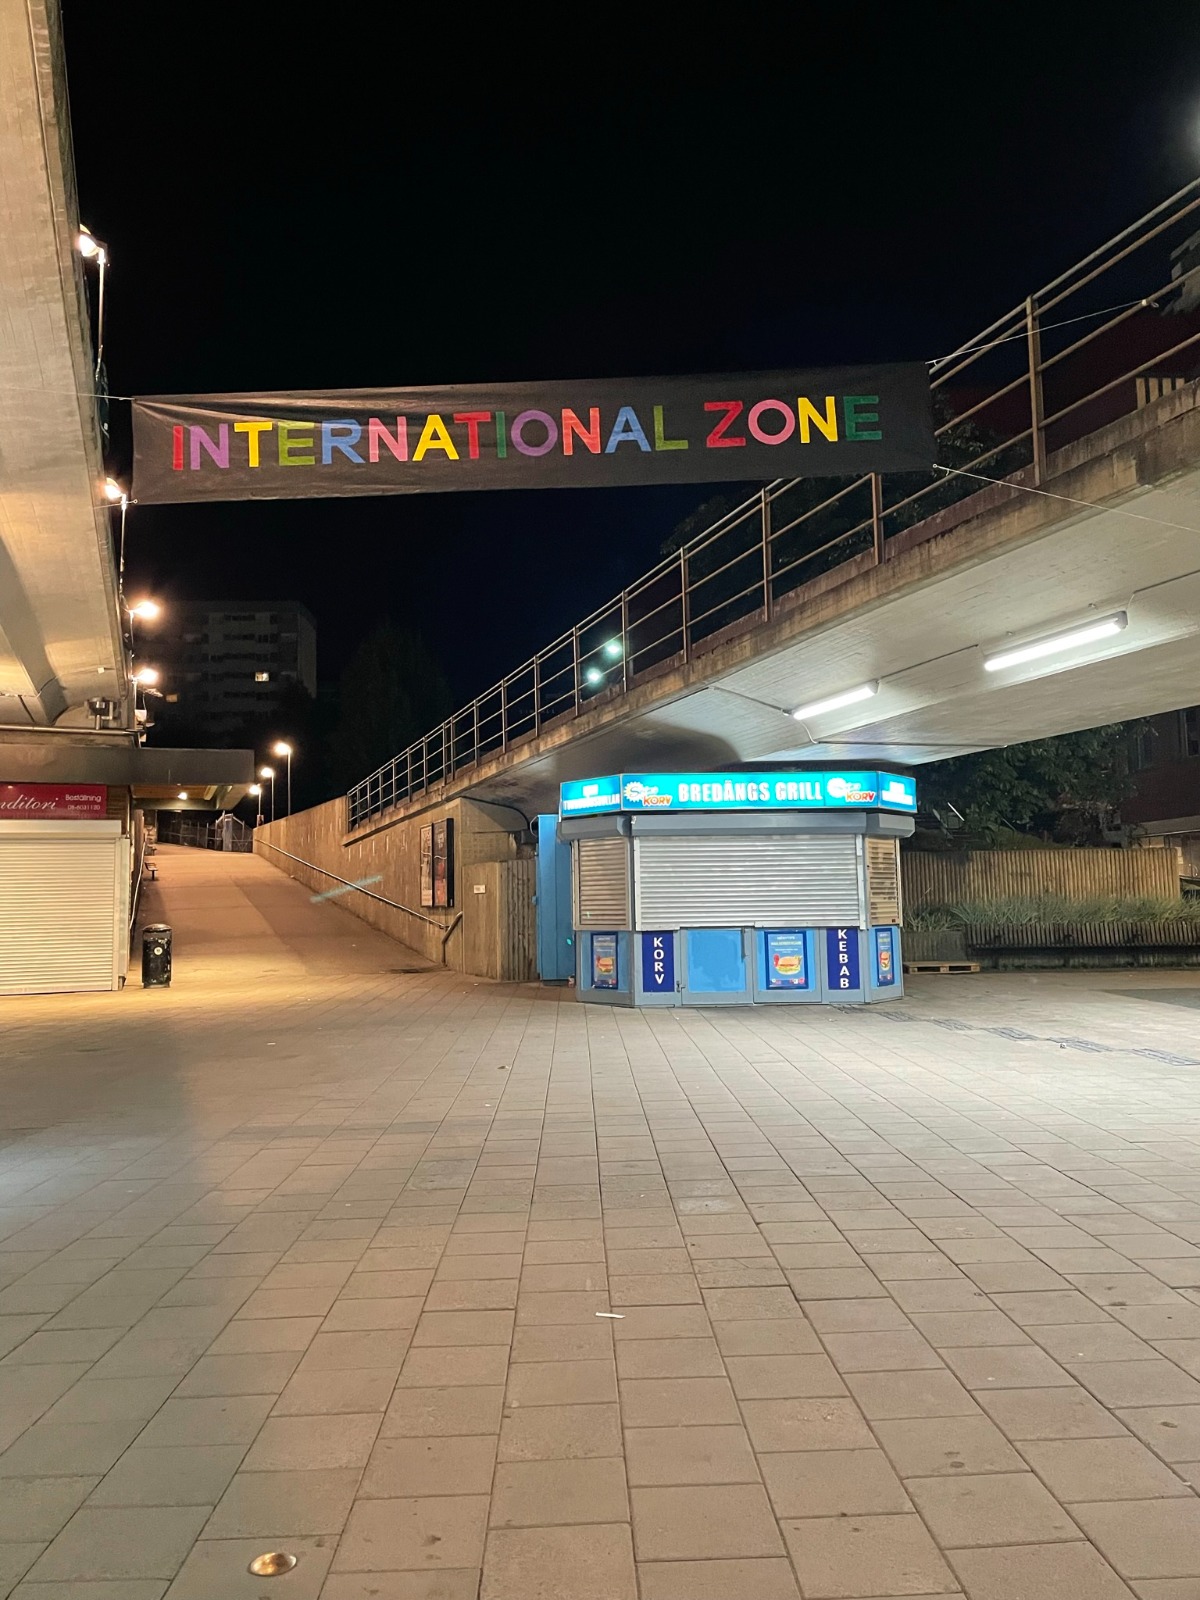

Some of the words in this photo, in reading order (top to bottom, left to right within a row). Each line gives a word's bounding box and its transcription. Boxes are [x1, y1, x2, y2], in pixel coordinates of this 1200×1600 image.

[172, 404, 689, 471] INTERNATIONAL
[703, 395, 883, 448] ZONE
[643, 795, 673, 806] KORV
[775, 781, 823, 801] GRILL
[846, 791, 875, 802] KORV
[653, 936, 665, 985] KORV
[837, 929, 850, 989] KEBAB
